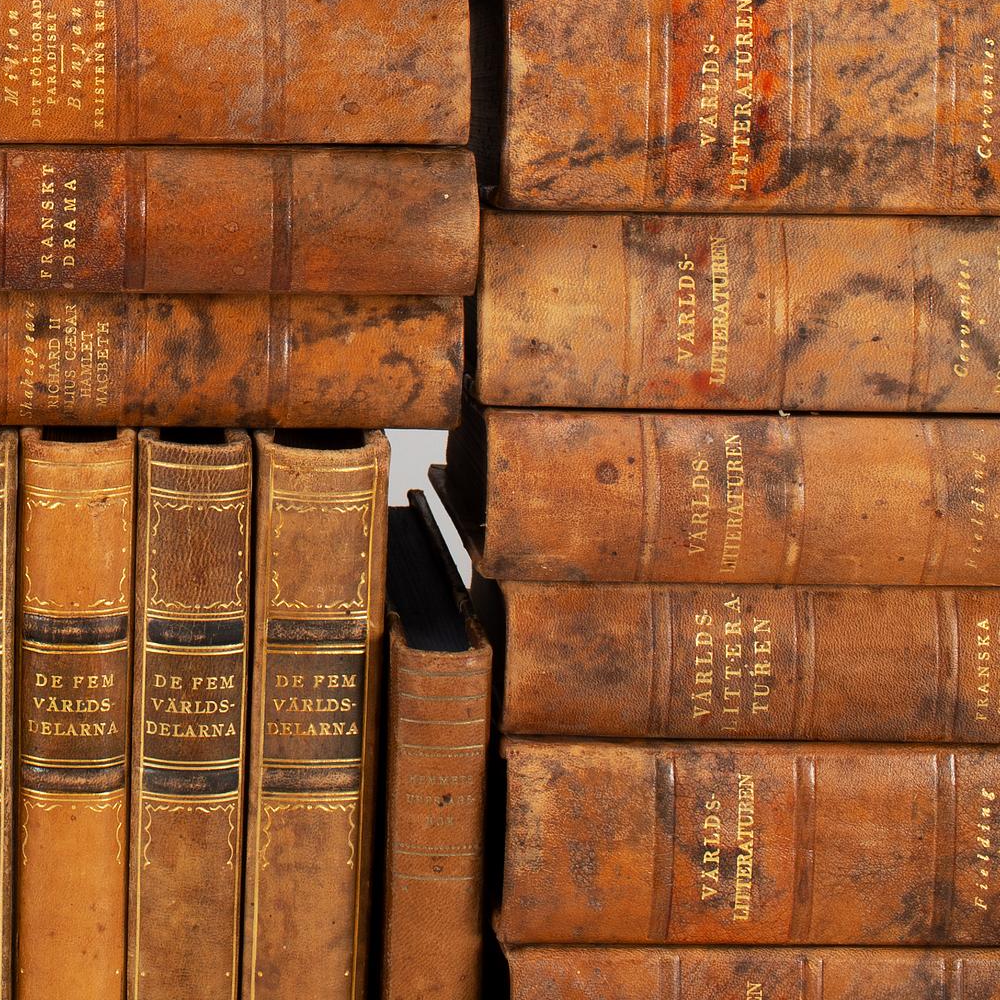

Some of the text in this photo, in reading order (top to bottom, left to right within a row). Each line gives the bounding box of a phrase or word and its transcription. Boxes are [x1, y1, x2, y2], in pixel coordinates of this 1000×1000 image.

[3, 9, 20, 108] Milton
[46, 10, 58, 106] PARADISET
[67, 5, 86, 111] Bunyan
[94, 41, 106, 130] KRISTENS
[698, 33, 721, 148] VÄRLDS-
[31, 96, 42, 129] DET
[40, 163, 56, 280] FRANSKT
[63, 178, 78, 267] DRAMA
[675, 252, 697, 364] VÄRLDS-
[707, 236, 731, 387] LITTERATUREN
[952, 258, 972, 379] Cervantes
[47, 337, 62, 409] RICHARD
[63, 303, 79, 417] LIUS CÆSAR
[80, 328, 94, 399] HAMLET
[96, 320, 111, 409] MACBETH
[687, 451, 711, 555] VÄRLDS-
[719, 433, 745, 575] LITTERATUREN
[33, 696, 116, 713] VÄRLDS-
[35, 673, 114, 689] DE FEM
[150, 697, 236, 714] VÄRLDS-
[153, 673, 235, 690] DE FEM
[272, 697, 357, 713] VÄRLDS-
[275, 673, 358, 689] DE FEM
[691, 608, 714, 719] VÄRLDS-
[720, 592, 743, 732] LITTERA-
[752, 616, 772, 715] TUREN
[975, 618, 991, 721] FRANSKA
[28, 719, 119, 736] DELARNA
[146, 720, 237, 738] DELARNA
[266, 721, 359, 736] DELARNA
[700, 792, 721, 900] VÄRLDS-
[733, 772, 755, 922] LITTERATUREN
[973, 787, 995, 911] Fielding
